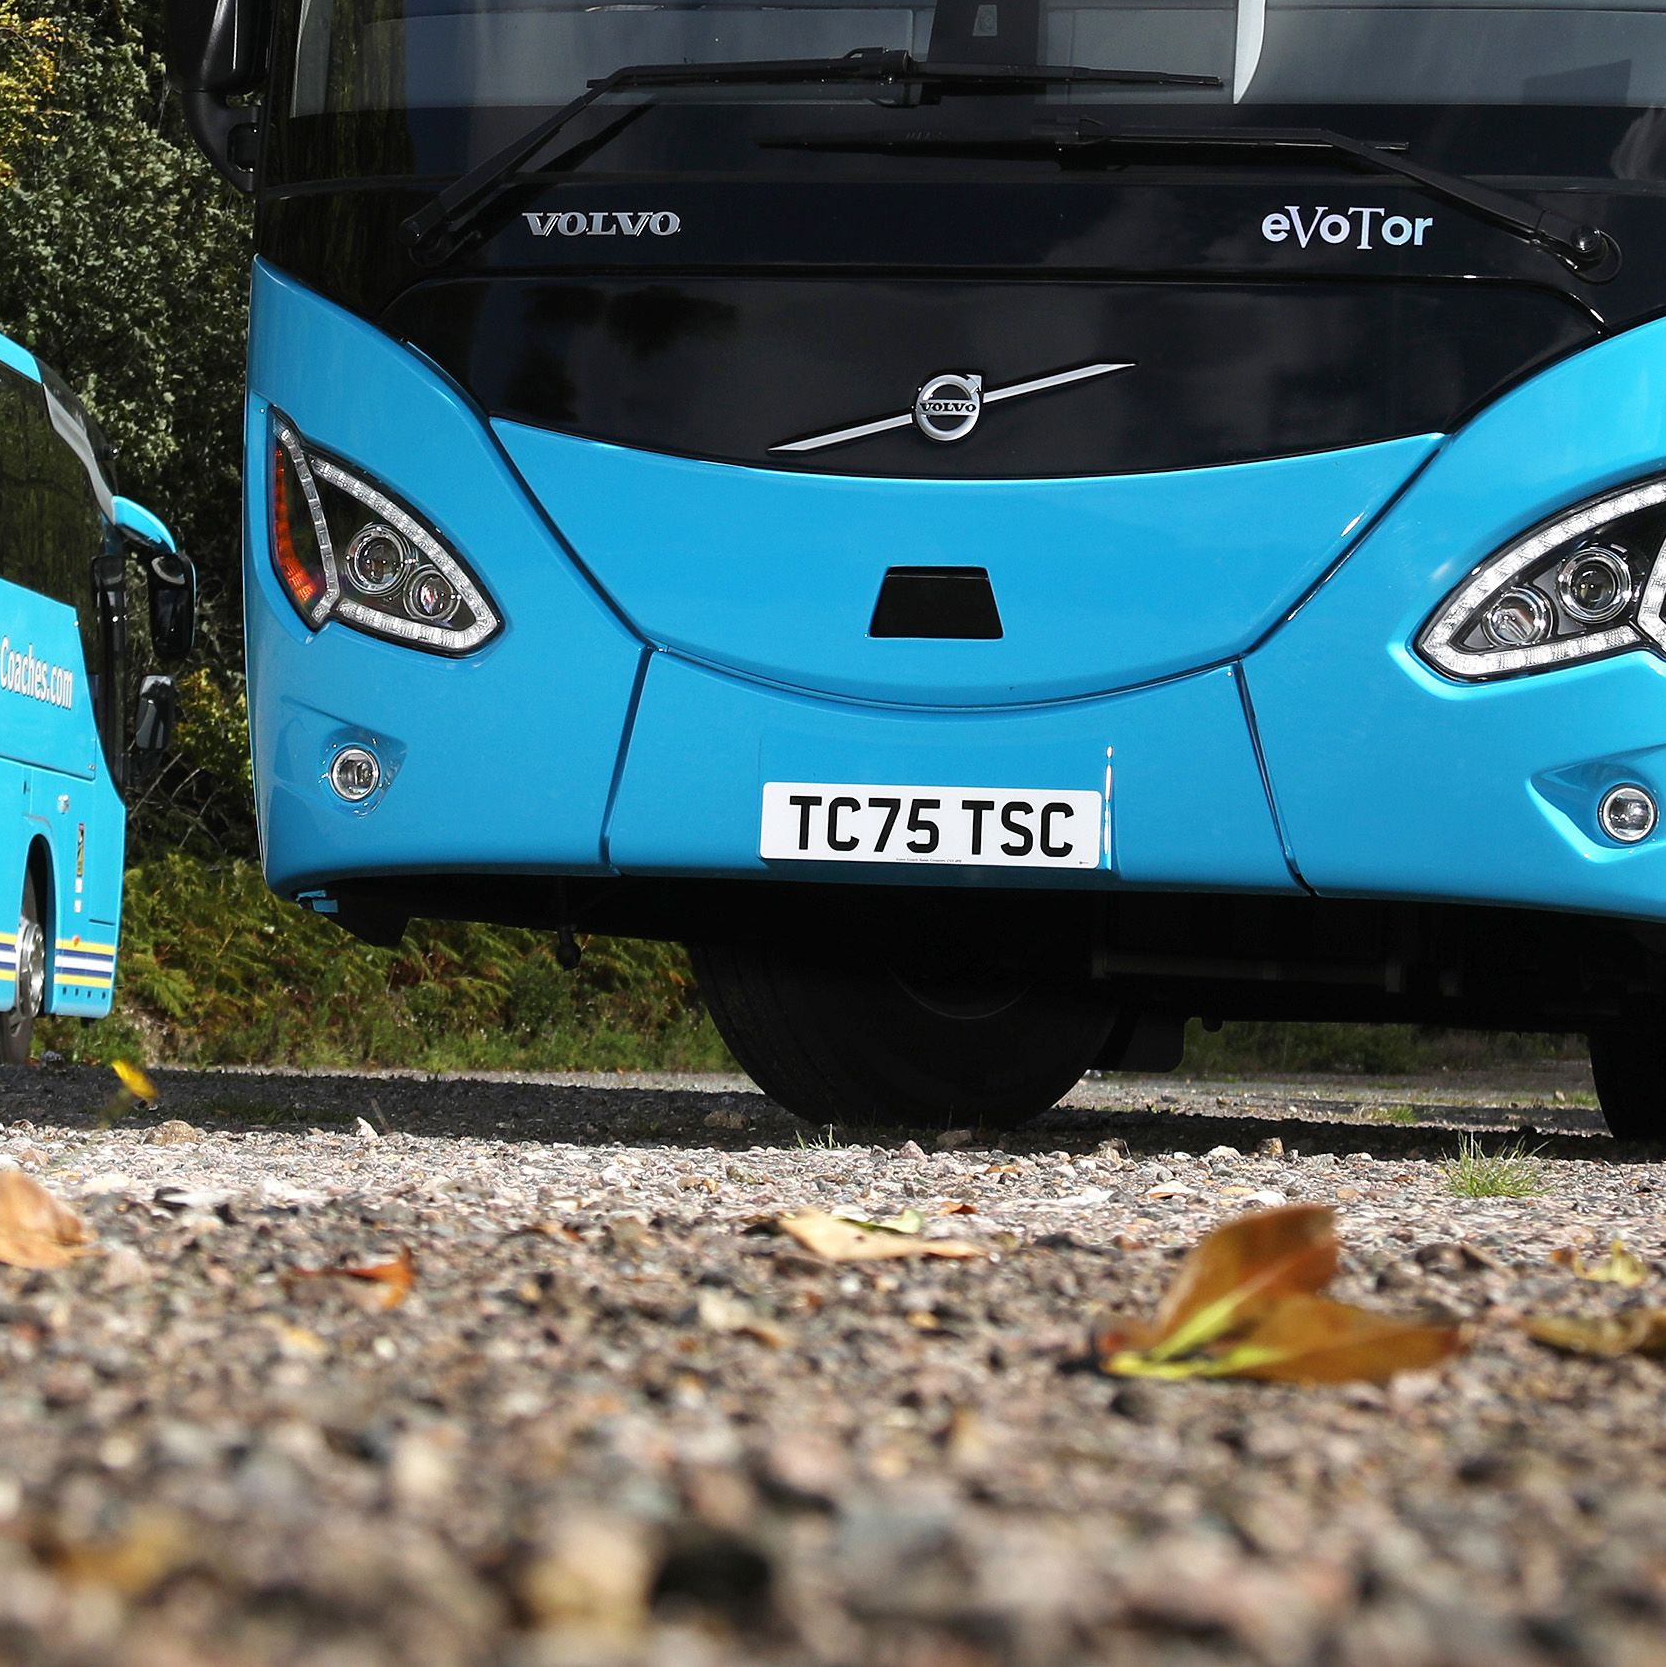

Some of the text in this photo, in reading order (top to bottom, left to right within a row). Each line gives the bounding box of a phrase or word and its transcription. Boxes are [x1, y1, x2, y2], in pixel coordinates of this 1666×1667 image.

[522, 211, 681, 237] VOLVO
[1261, 205, 1433, 250] eVoTor
[919, 400, 977, 415] VOLVO
[0, 635, 74, 711] Coaches.com
[788, 795, 1075, 859] TC75 TSC
